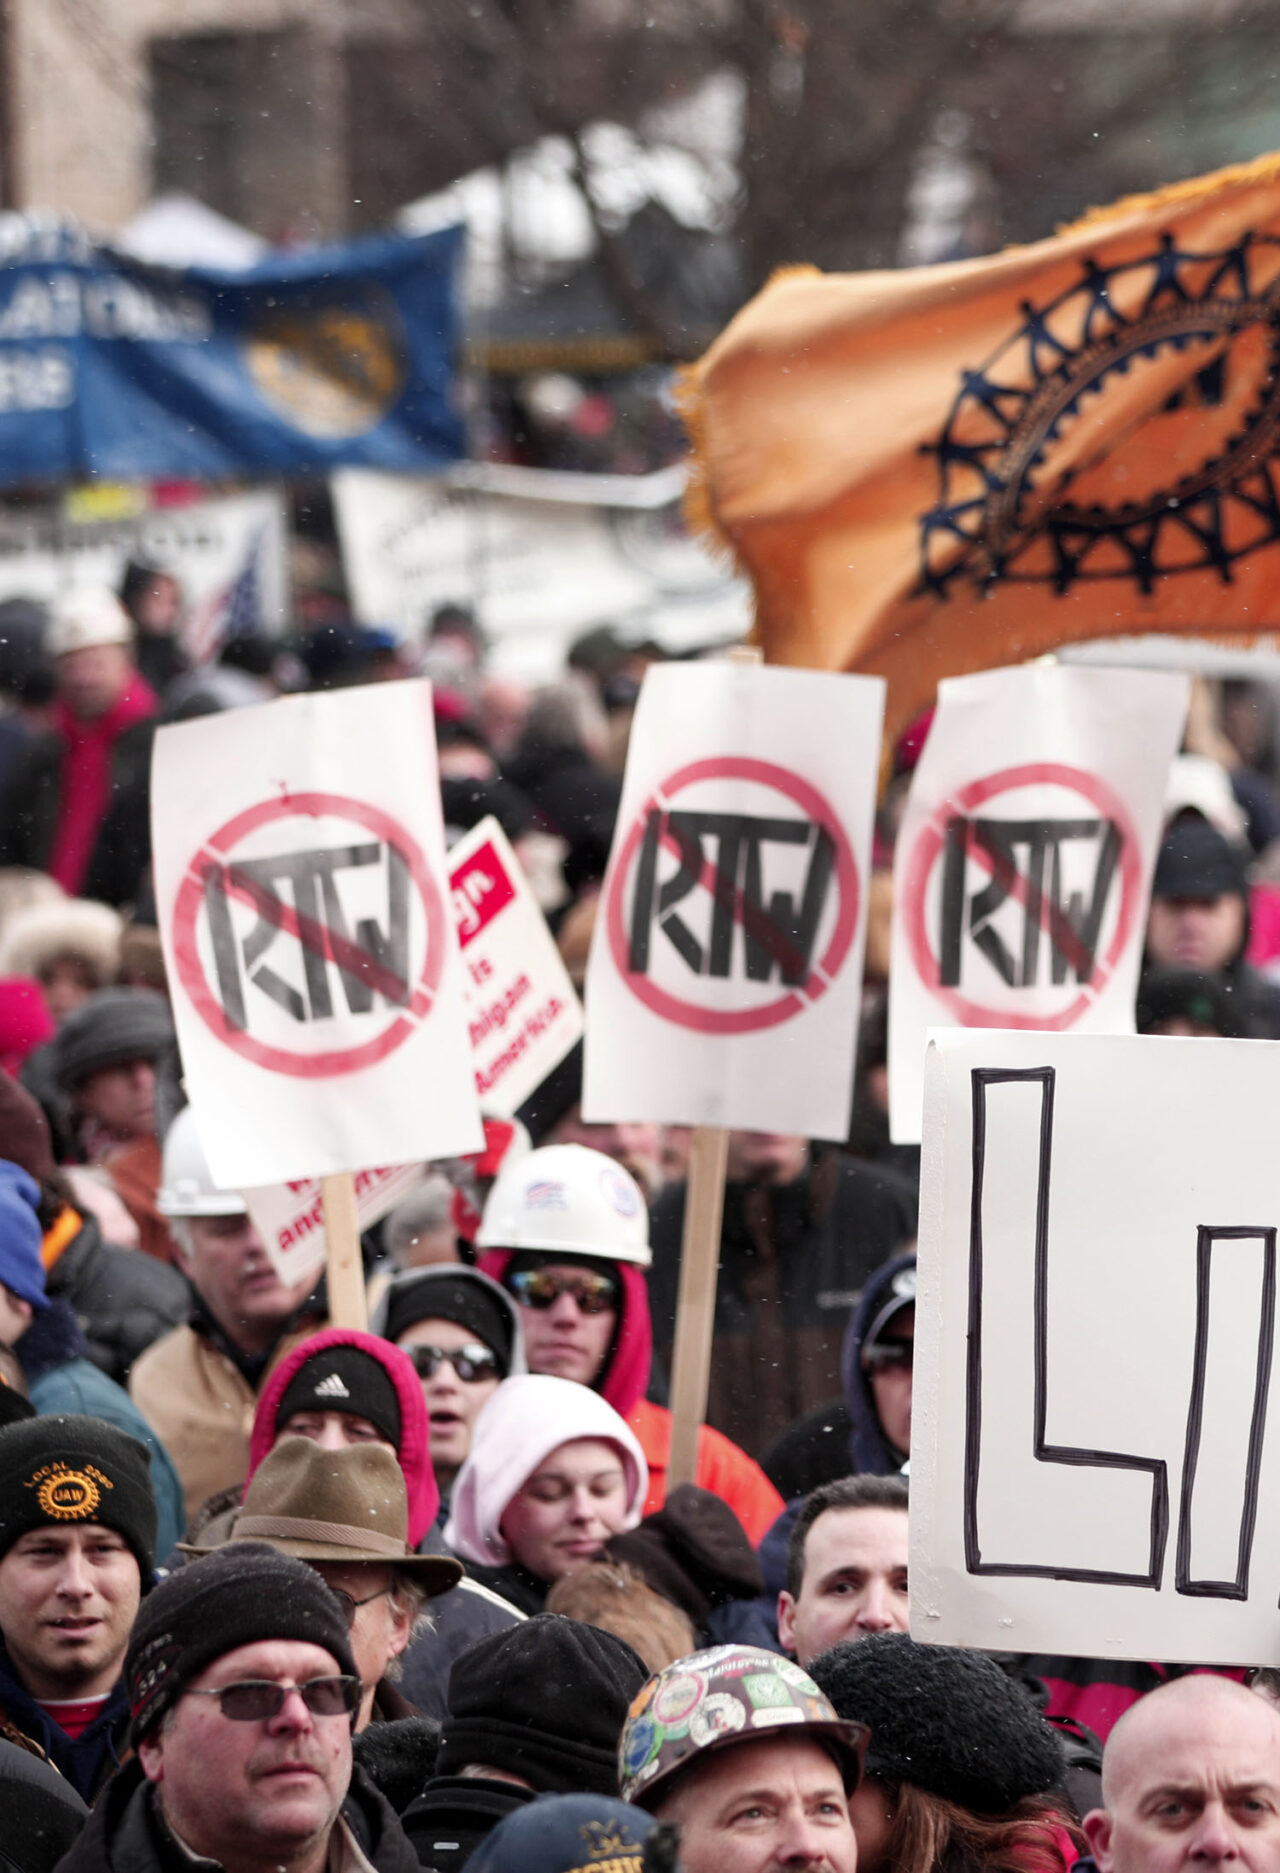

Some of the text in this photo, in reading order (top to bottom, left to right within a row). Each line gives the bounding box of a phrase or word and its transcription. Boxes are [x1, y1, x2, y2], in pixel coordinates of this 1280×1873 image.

[202, 837, 412, 1032] RTW
[628, 809, 837, 989] RTW
[939, 815, 1123, 990] RTW
[22, 1460, 70, 1488] LOCAL
[53, 1488, 85, 1502] UAW
